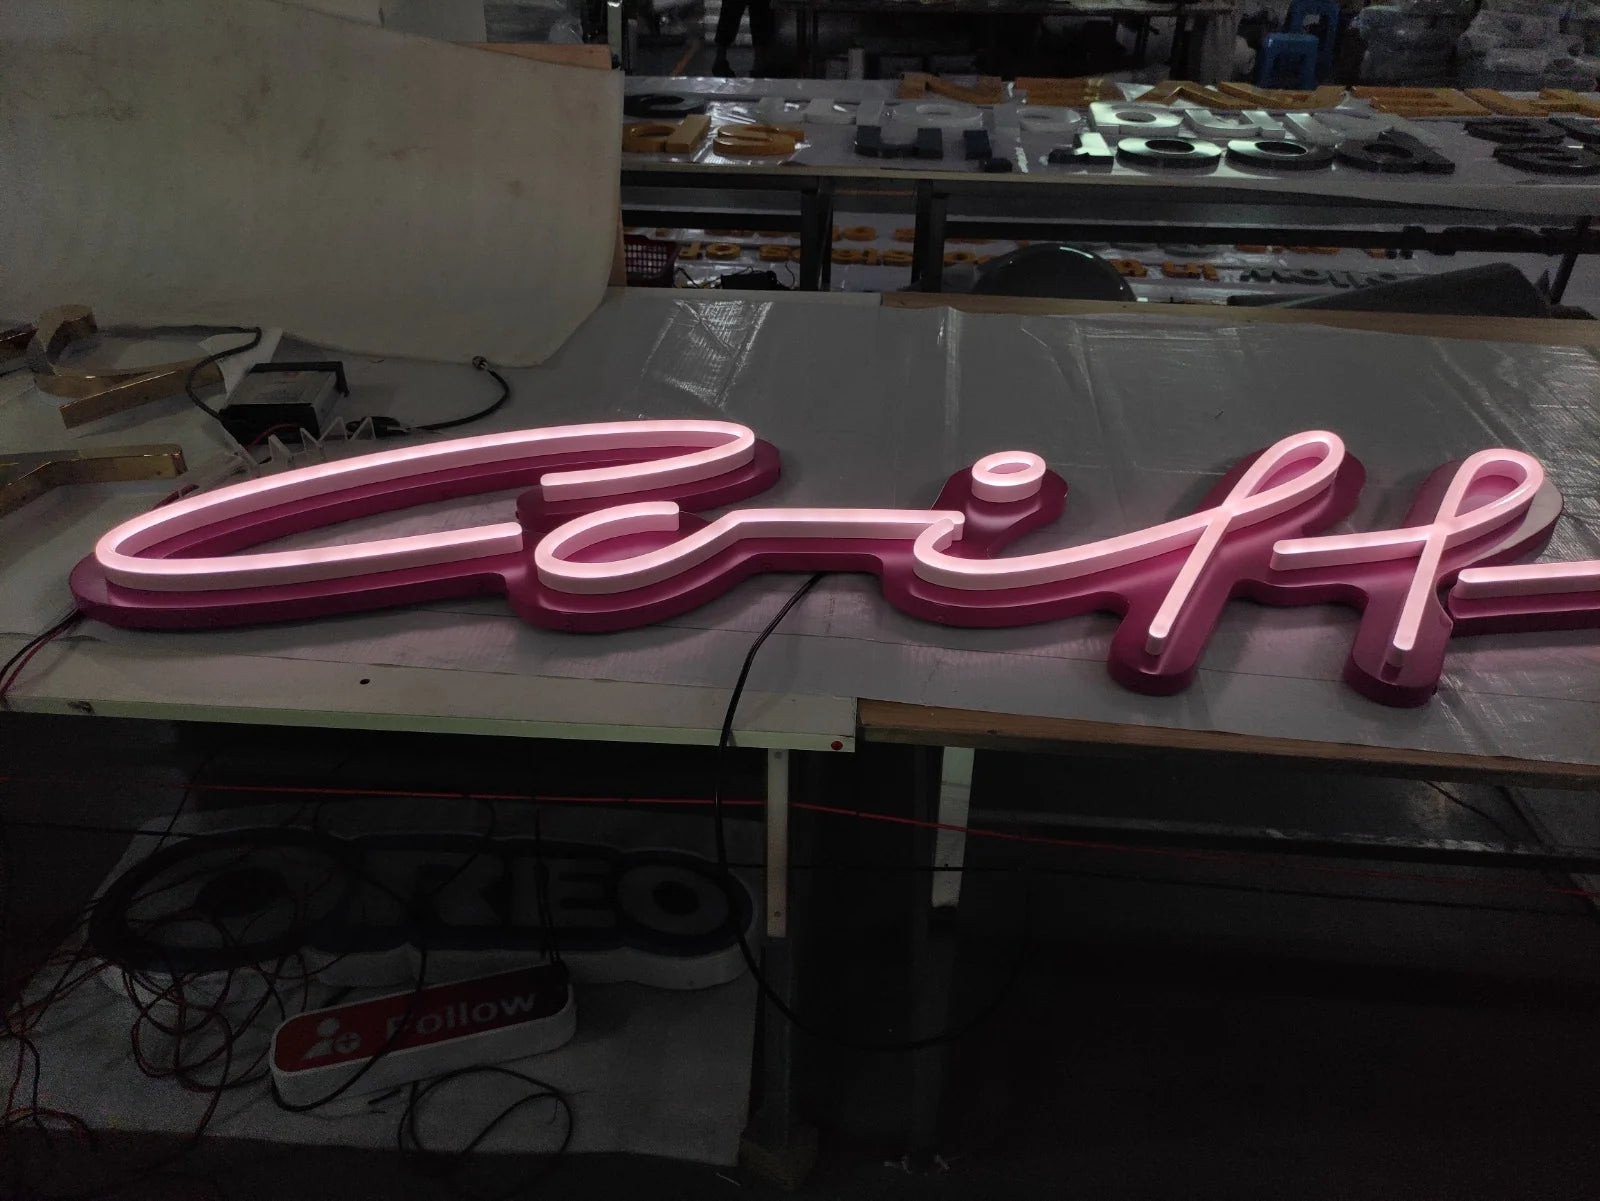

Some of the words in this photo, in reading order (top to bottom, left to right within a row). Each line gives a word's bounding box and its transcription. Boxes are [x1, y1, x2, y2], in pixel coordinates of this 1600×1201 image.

[92, 418, 1600, 668] Coiff
[123, 843, 734, 950] OREO
[385, 992, 536, 1042] Follow
